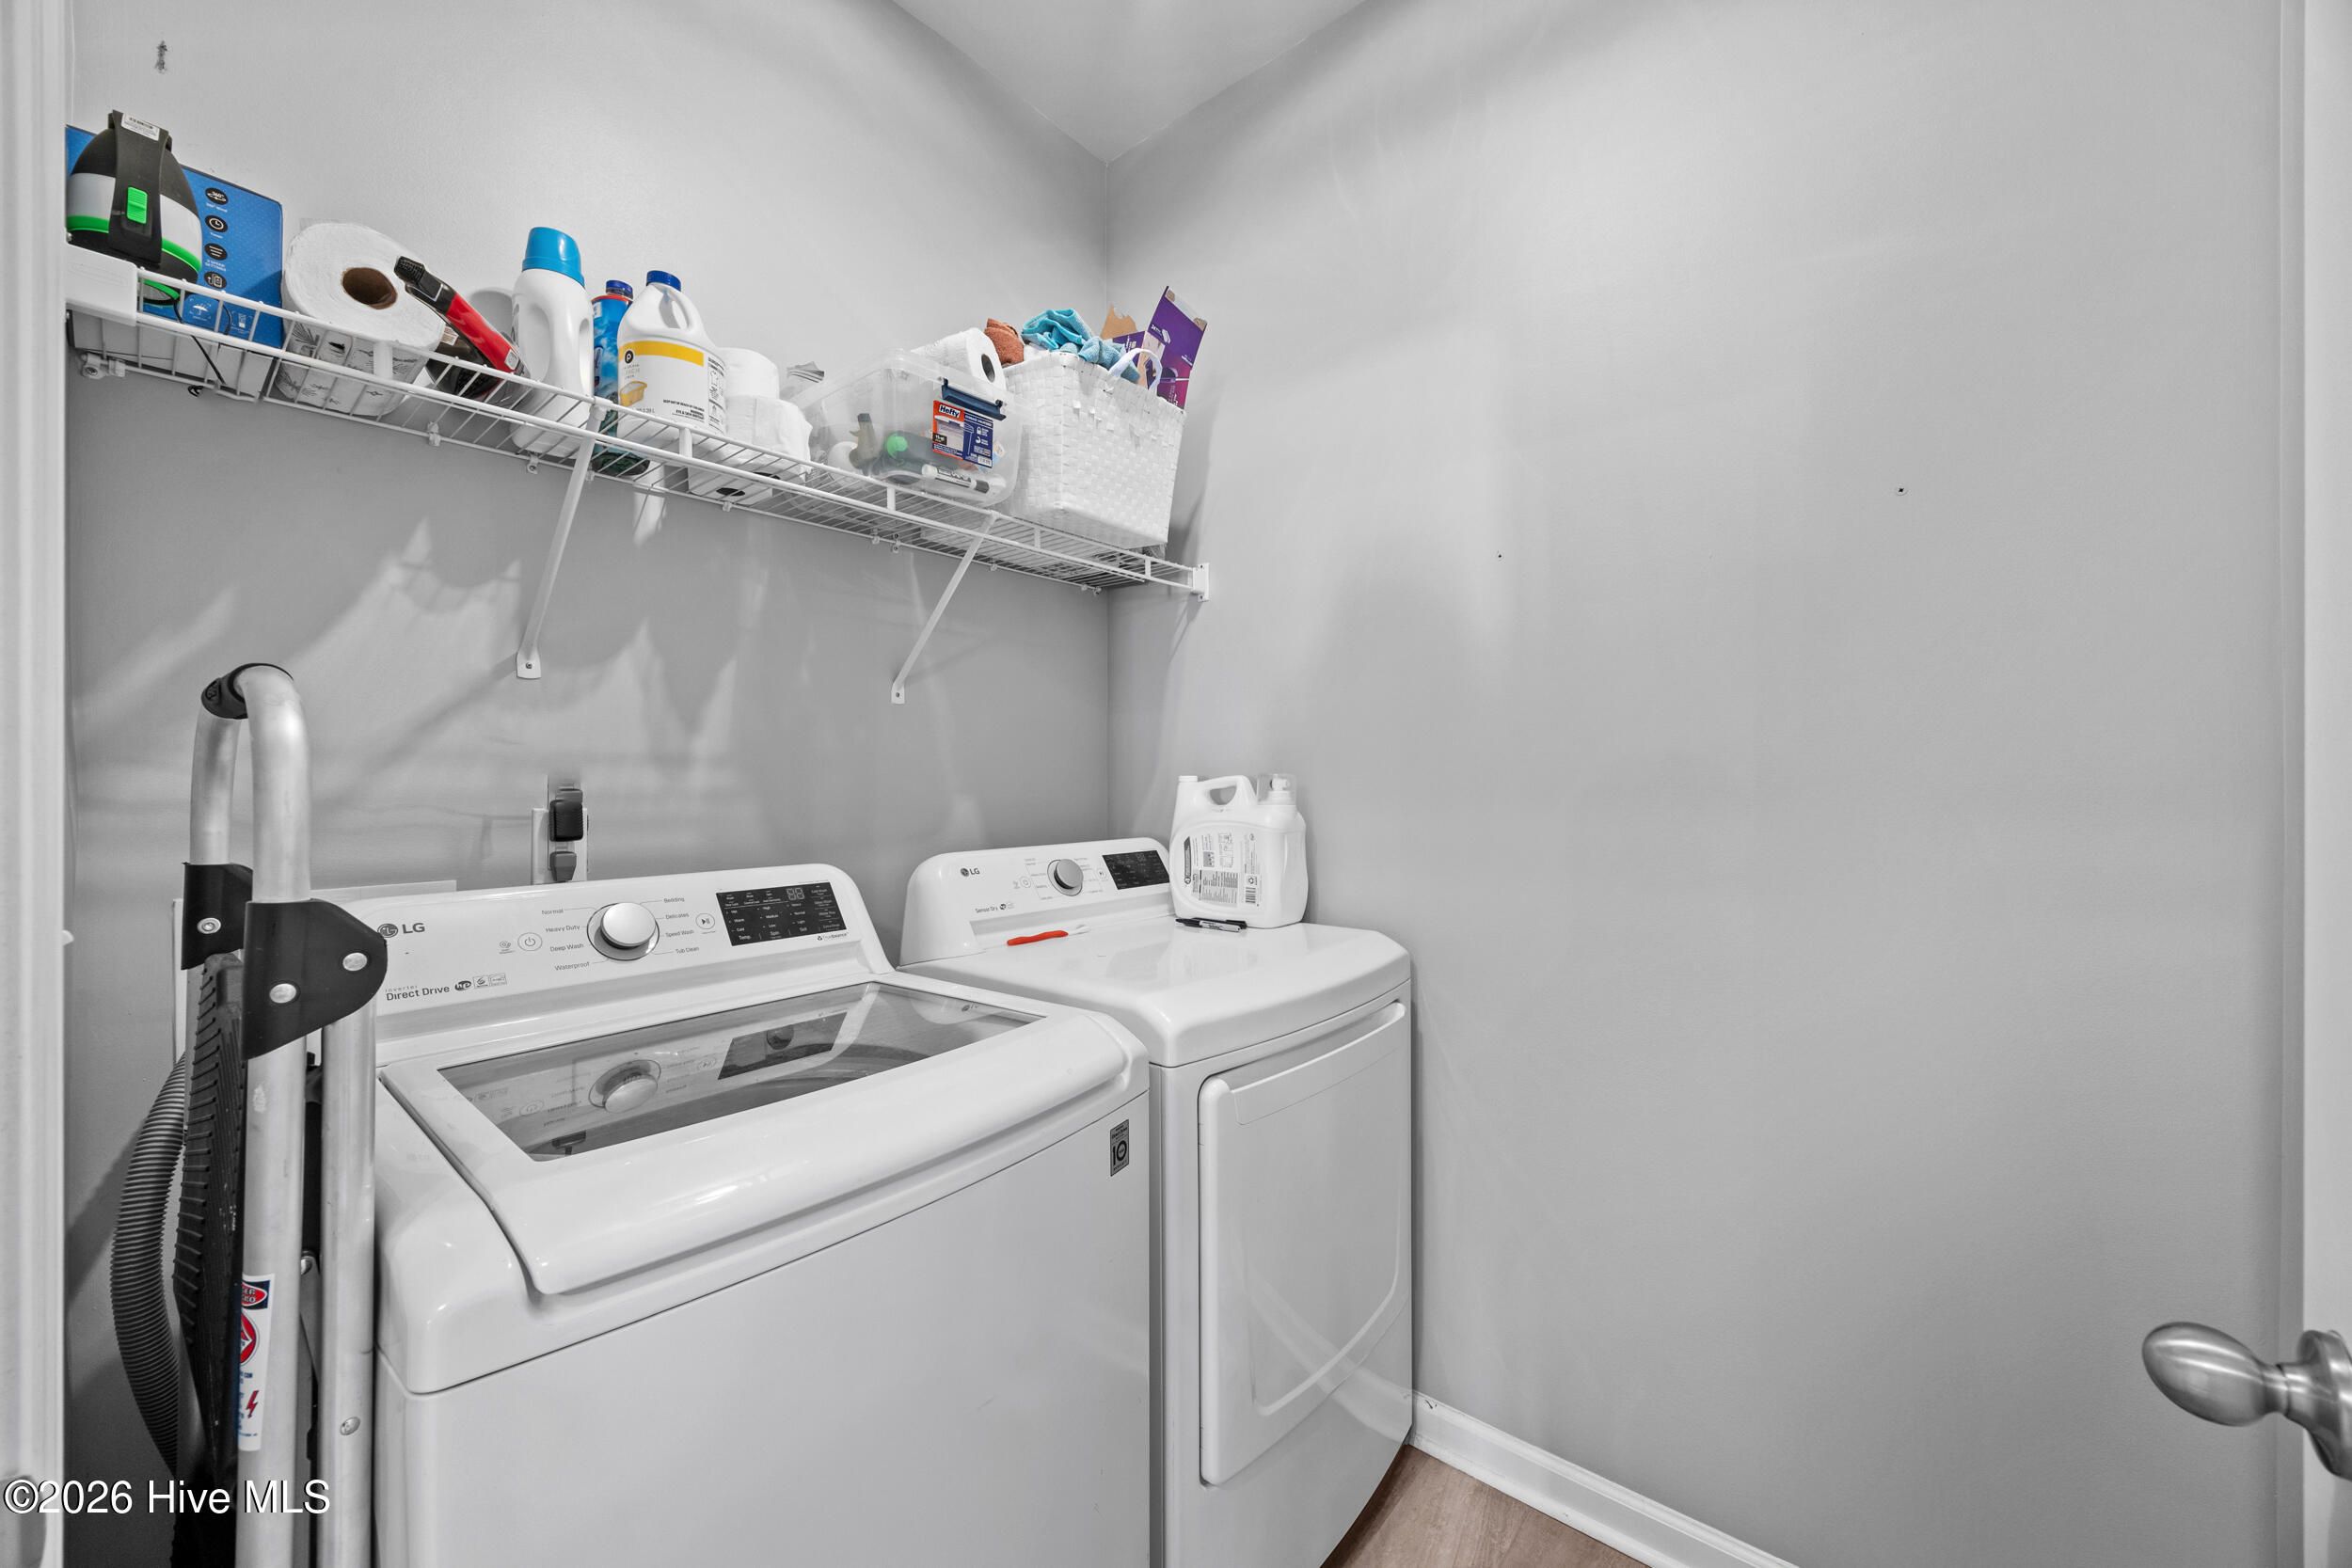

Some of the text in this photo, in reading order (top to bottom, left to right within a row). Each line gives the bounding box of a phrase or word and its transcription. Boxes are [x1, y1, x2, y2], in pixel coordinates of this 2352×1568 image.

[940, 404, 960, 418] Hefty
[402, 922, 426, 934] LG
[546, 925, 565, 933] Heavy
[554, 961, 590, 971] Waterproof
[386, 986, 450, 1001] Direct Drive
